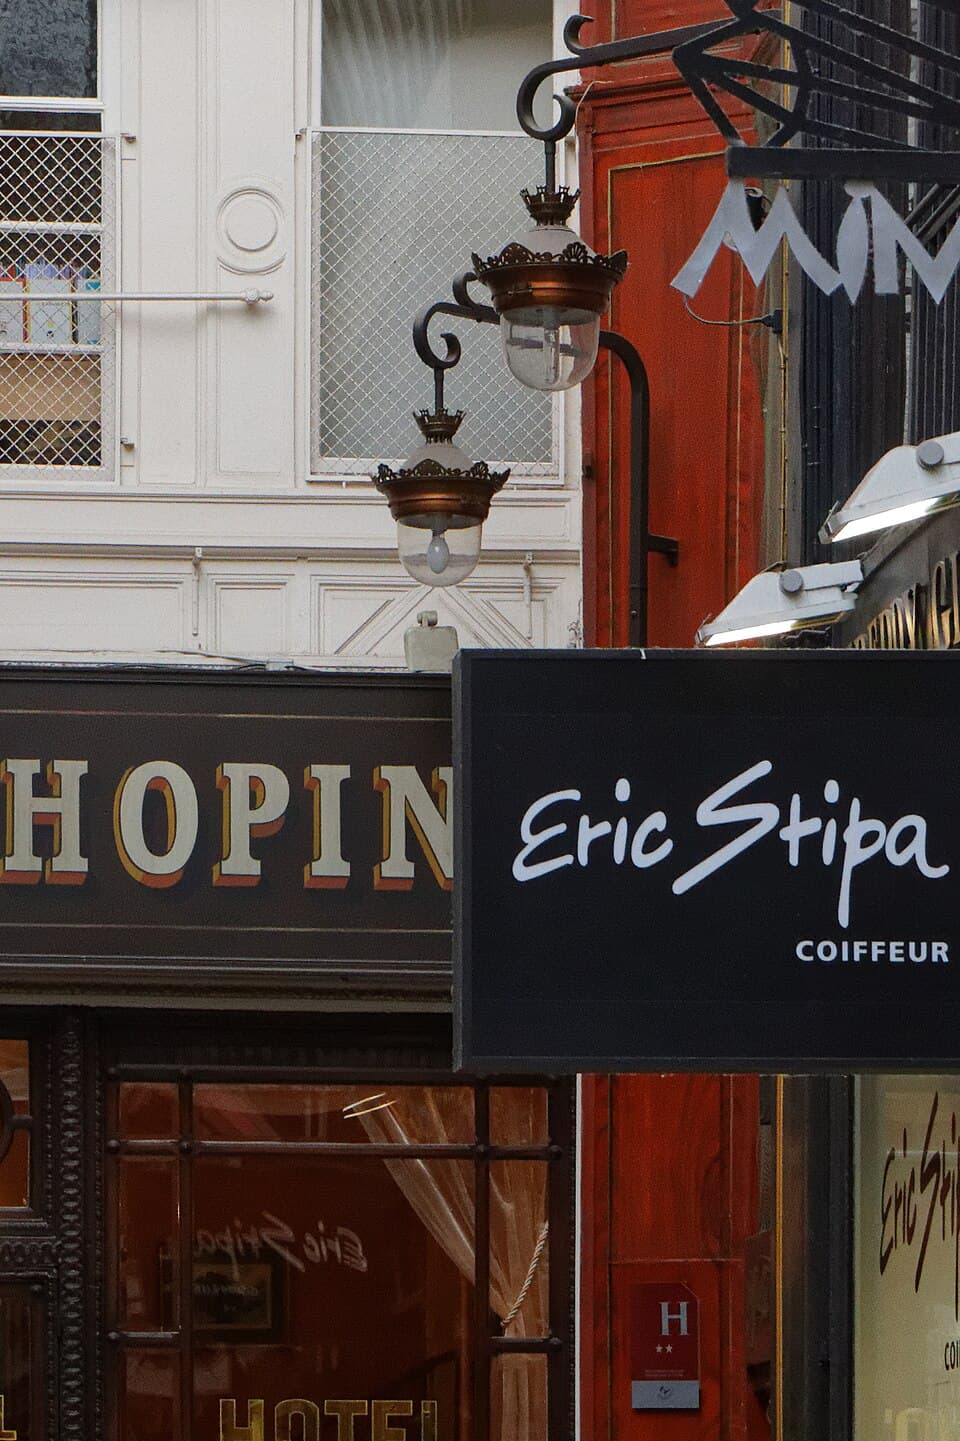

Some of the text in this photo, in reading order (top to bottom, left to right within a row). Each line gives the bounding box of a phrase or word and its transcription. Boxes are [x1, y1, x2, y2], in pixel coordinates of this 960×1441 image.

[512, 759, 950, 929] Eric Stipa
[796, 940, 950, 963] COIFFEUR
[659, 1301, 690, 1336] H
